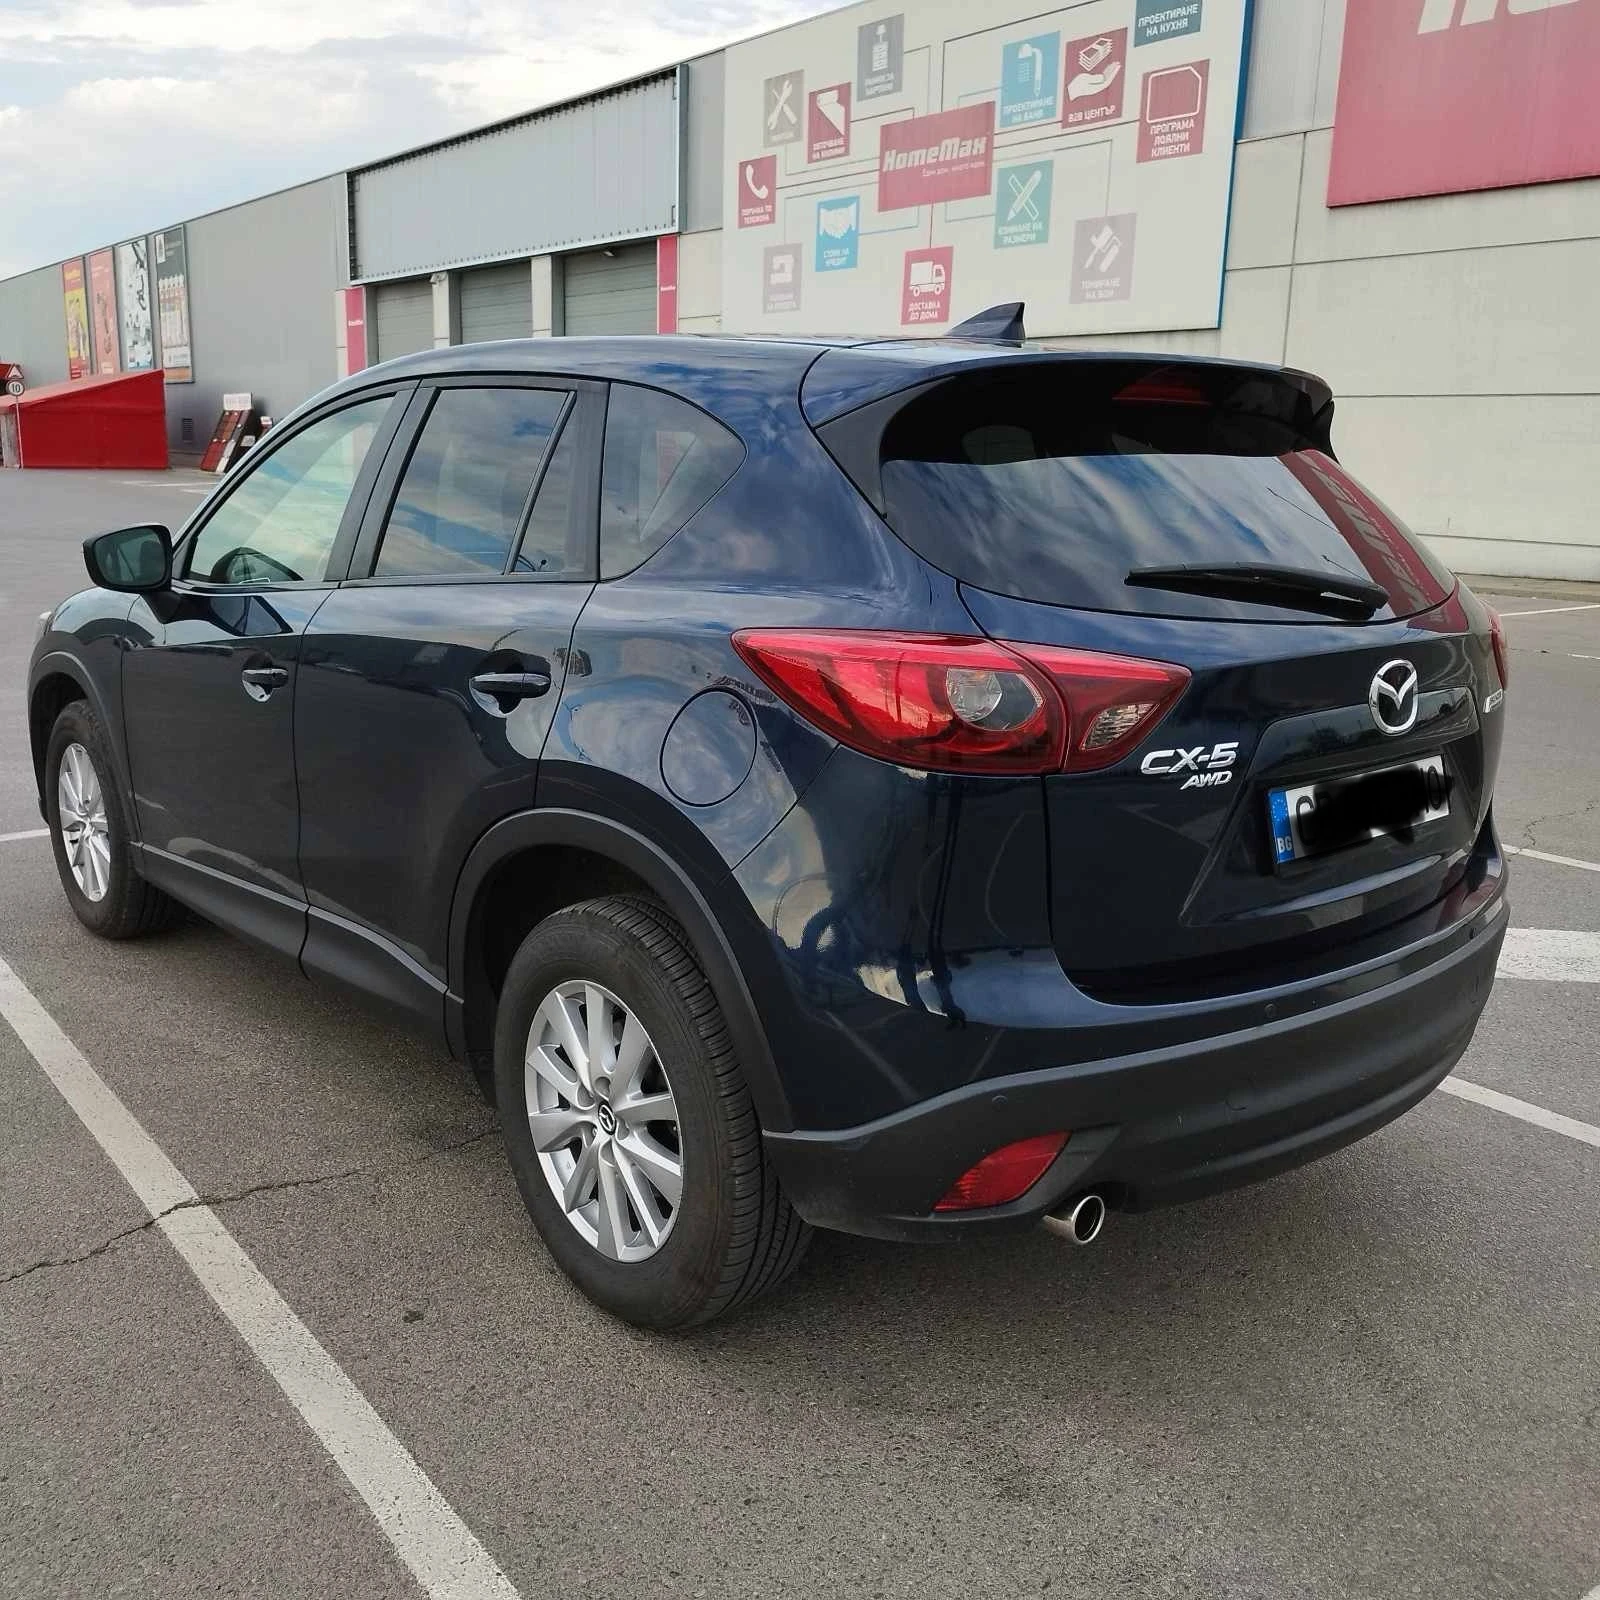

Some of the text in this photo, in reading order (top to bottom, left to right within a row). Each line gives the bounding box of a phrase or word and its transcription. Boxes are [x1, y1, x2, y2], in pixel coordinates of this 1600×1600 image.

[1138, 4, 1199, 28] ПРОЕКТИРАНЕ
[1146, 18, 1188, 37] НА КУХНЯ
[1084, 104, 1116, 121] ЦЕНТЪР
[1150, 118, 1194, 135] ПРОГРАМА
[1154, 132, 1189, 146] ЛОЯЛНИ
[883, 136, 987, 172] HomeMax
[1151, 143, 1191, 157] КЛИЕНТИ
[908, 301, 940, 312] ДОСТАВКА
[910, 311, 938, 321] ДО ДОМА
[11, 383, 21, 393] 10
[1140, 742, 1240, 774] CX-5
[1180, 771, 1232, 790] AWD
[1276, 837, 1293, 854] BG
